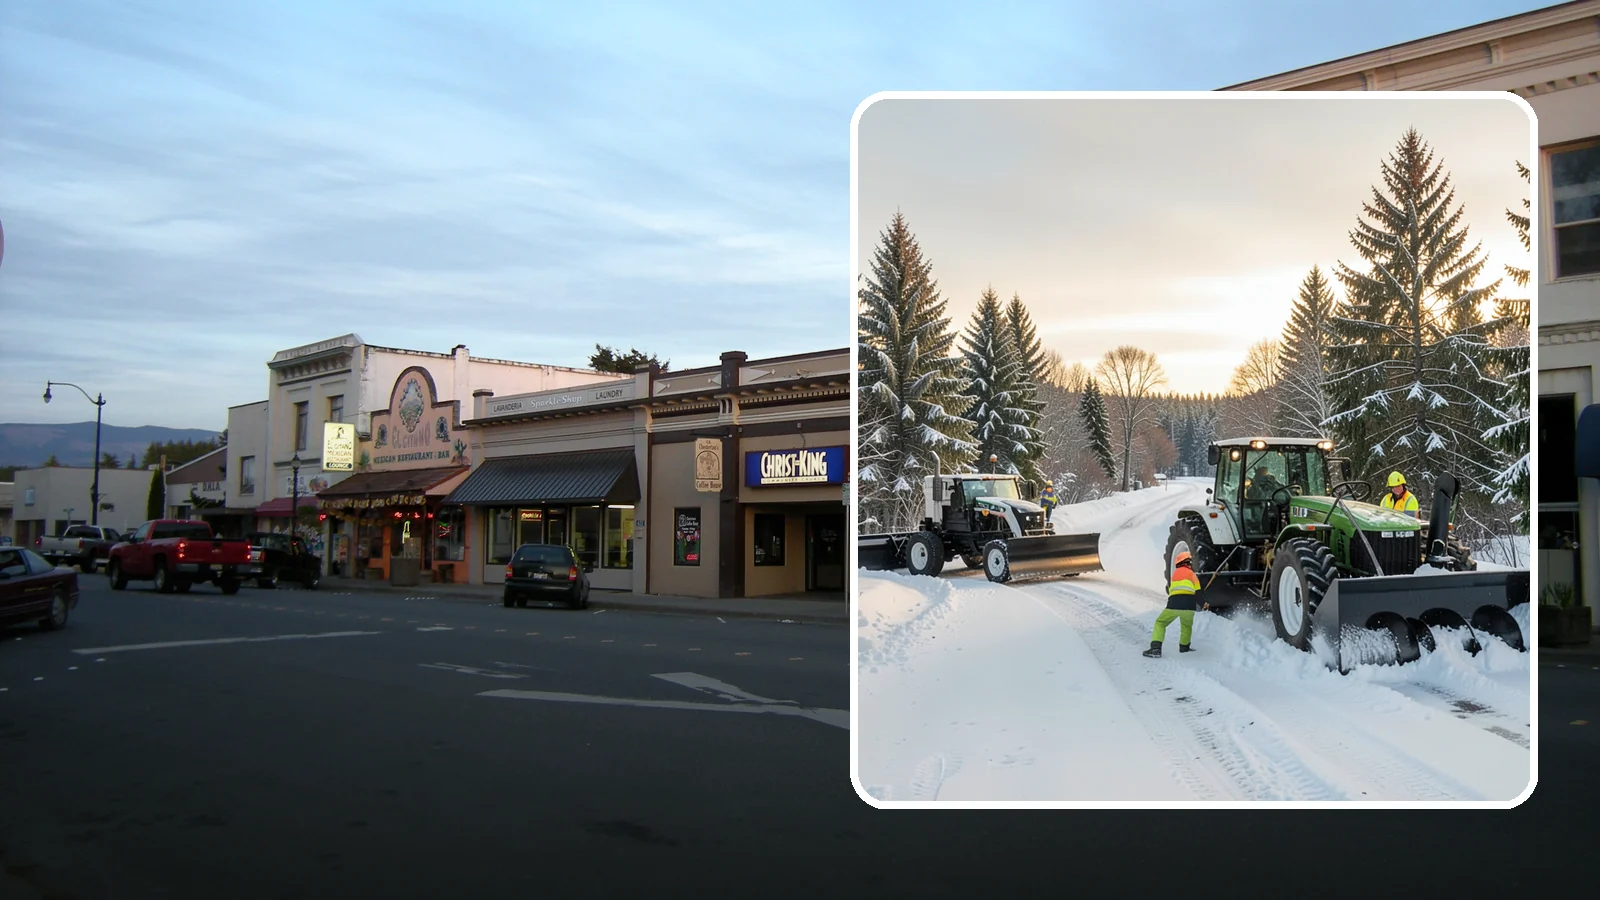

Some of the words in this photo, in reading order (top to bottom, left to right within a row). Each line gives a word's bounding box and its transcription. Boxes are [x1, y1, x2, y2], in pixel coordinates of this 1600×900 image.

[595, 389, 623, 400] LAUNDRY
[493, 402, 522, 412] LAVANDERIA
[531, 398, 560, 408] Sparkle
[562, 394, 582, 406] Shop
[397, 451, 433, 462] RESTAURANT
[437, 450, 450, 459] BAR
[761, 452, 797, 478] CHRIST
[799, 450, 827, 476] KING
